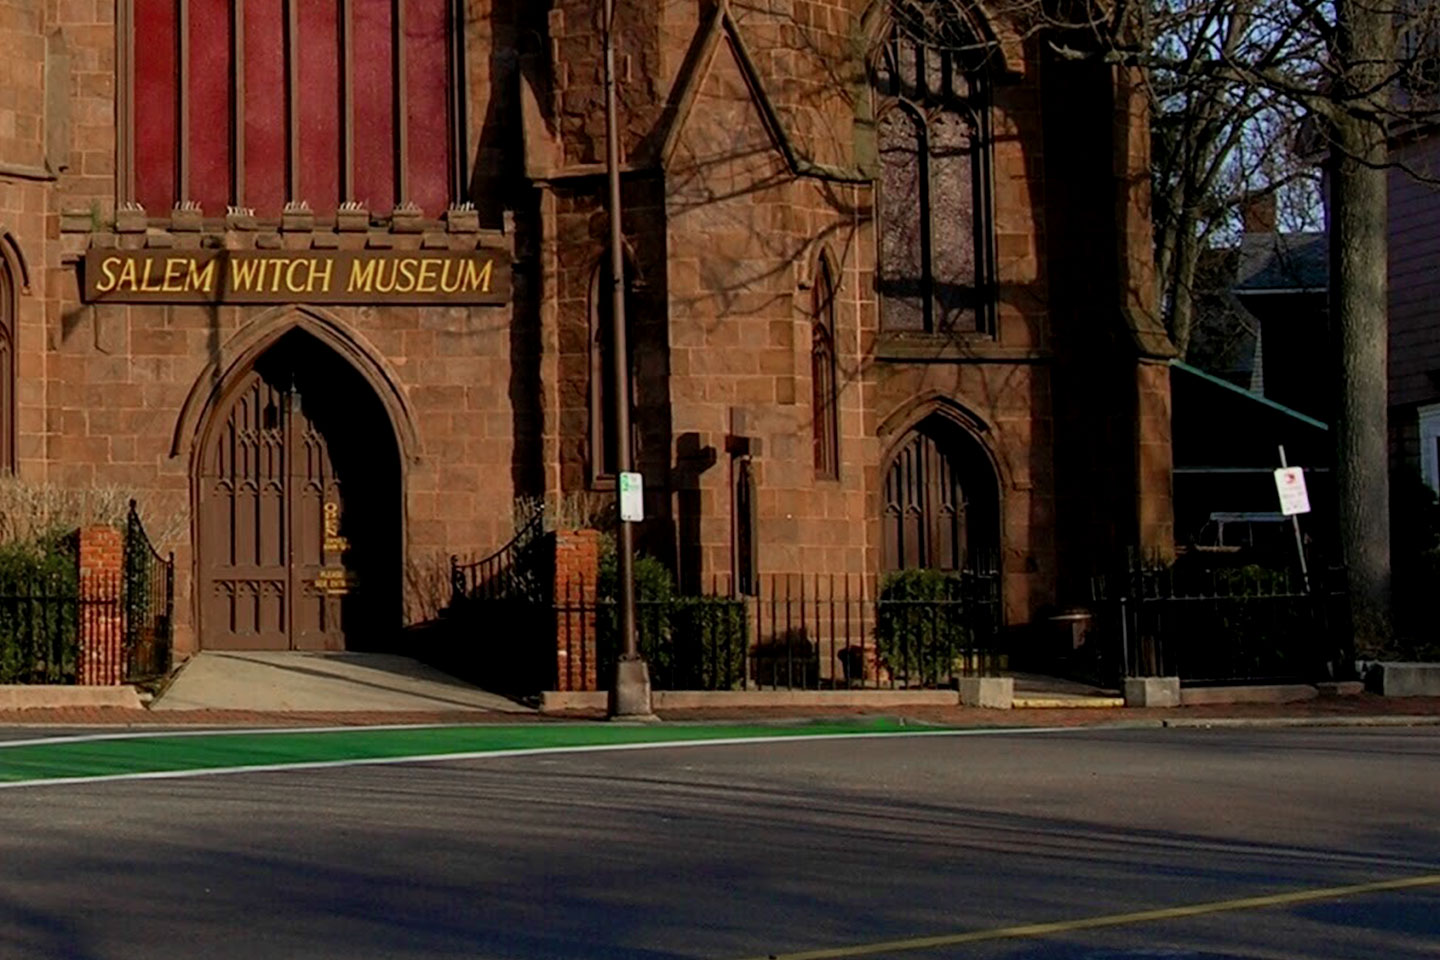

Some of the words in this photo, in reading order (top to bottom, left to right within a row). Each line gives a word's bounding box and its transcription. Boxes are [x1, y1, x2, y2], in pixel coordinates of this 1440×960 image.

[97, 257, 214, 292] SALEM
[231, 258, 333, 292] WITCH
[348, 258, 493, 292] MUSEUM
